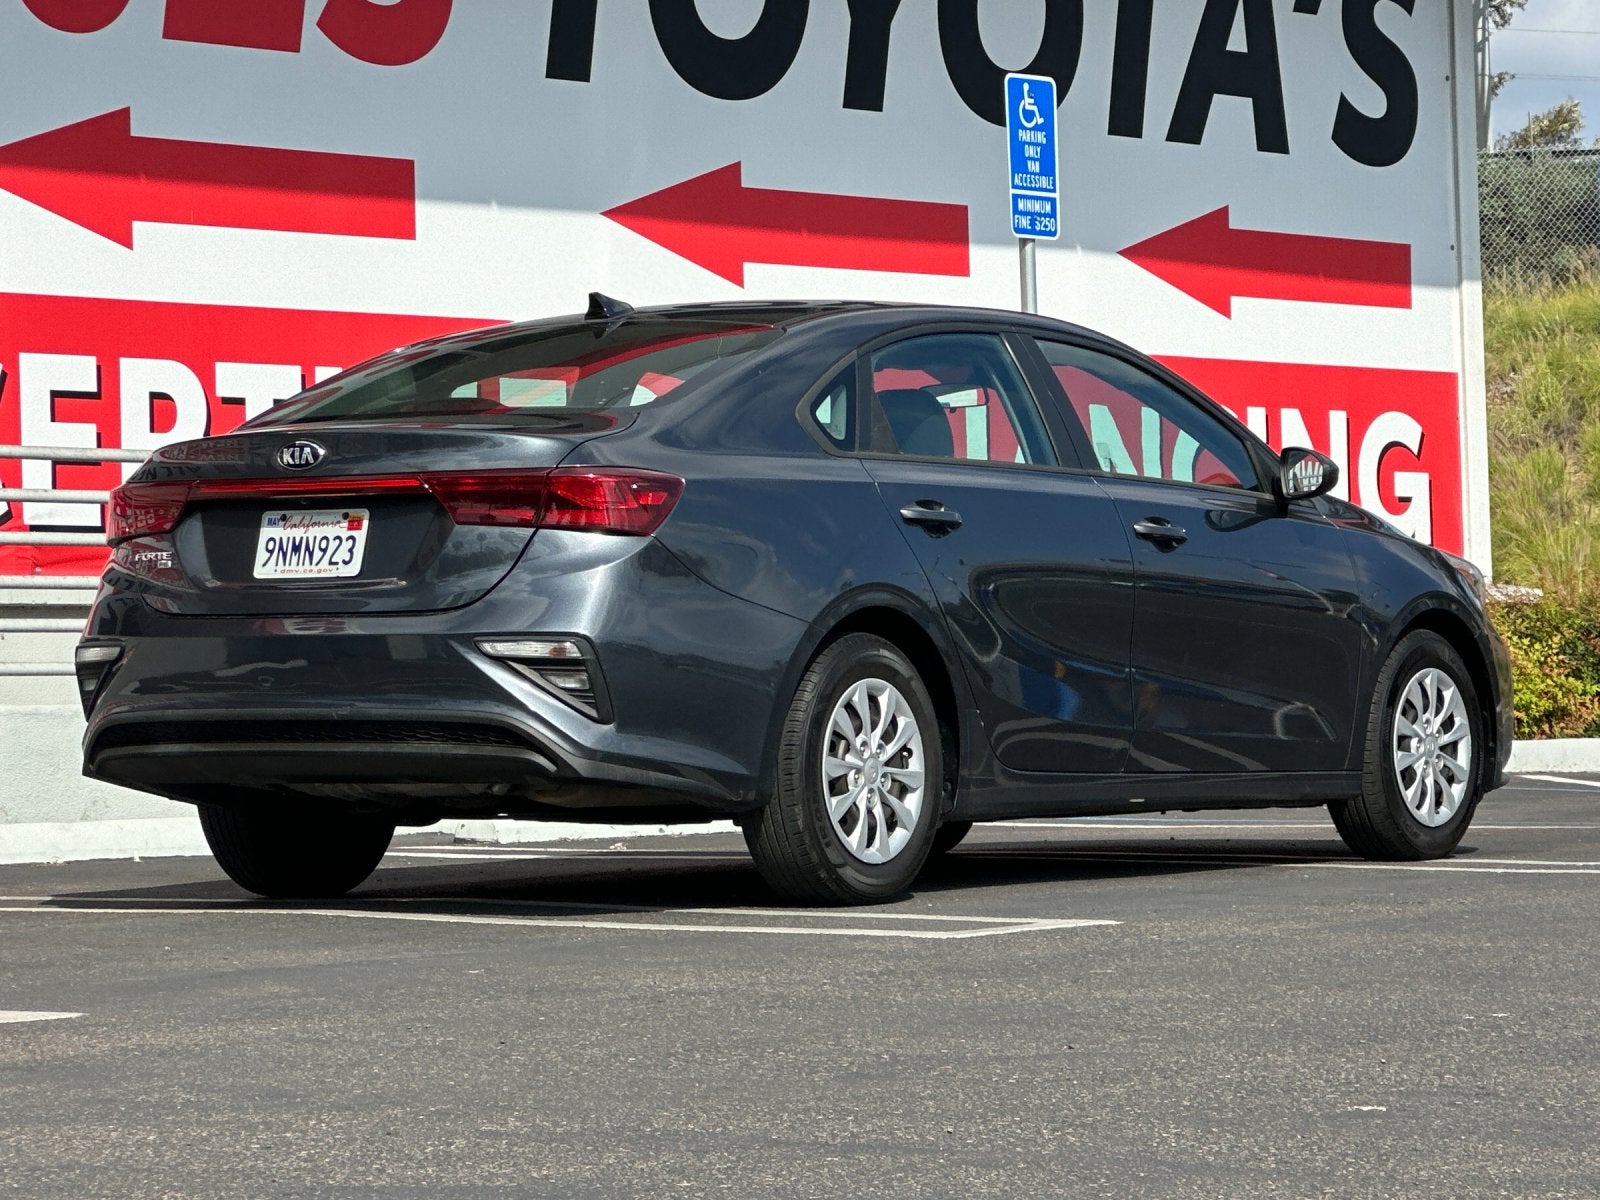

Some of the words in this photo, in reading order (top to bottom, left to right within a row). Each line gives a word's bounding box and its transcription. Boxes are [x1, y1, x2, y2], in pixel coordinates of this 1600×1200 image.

[546, 0, 1418, 167] YOTAS
[1018, 129, 1047, 144] PARKING
[1024, 144, 1041, 158] ONLY
[1027, 160, 1040, 173] VAN
[1014, 173, 1054, 189] ACCESSIBLE
[1018, 198, 1051, 214] MINIMUM
[1014, 214, 1032, 229] FINE
[1034, 215, 1056, 232] $250
[283, 447, 315, 465] KIA
[267, 517, 281, 527] MAY
[283, 514, 346, 534] California
[134, 551, 173, 561] FORTE
[262, 534, 357, 568] 9NMN923
[280, 567, 334, 575] dmv.ca.gov
